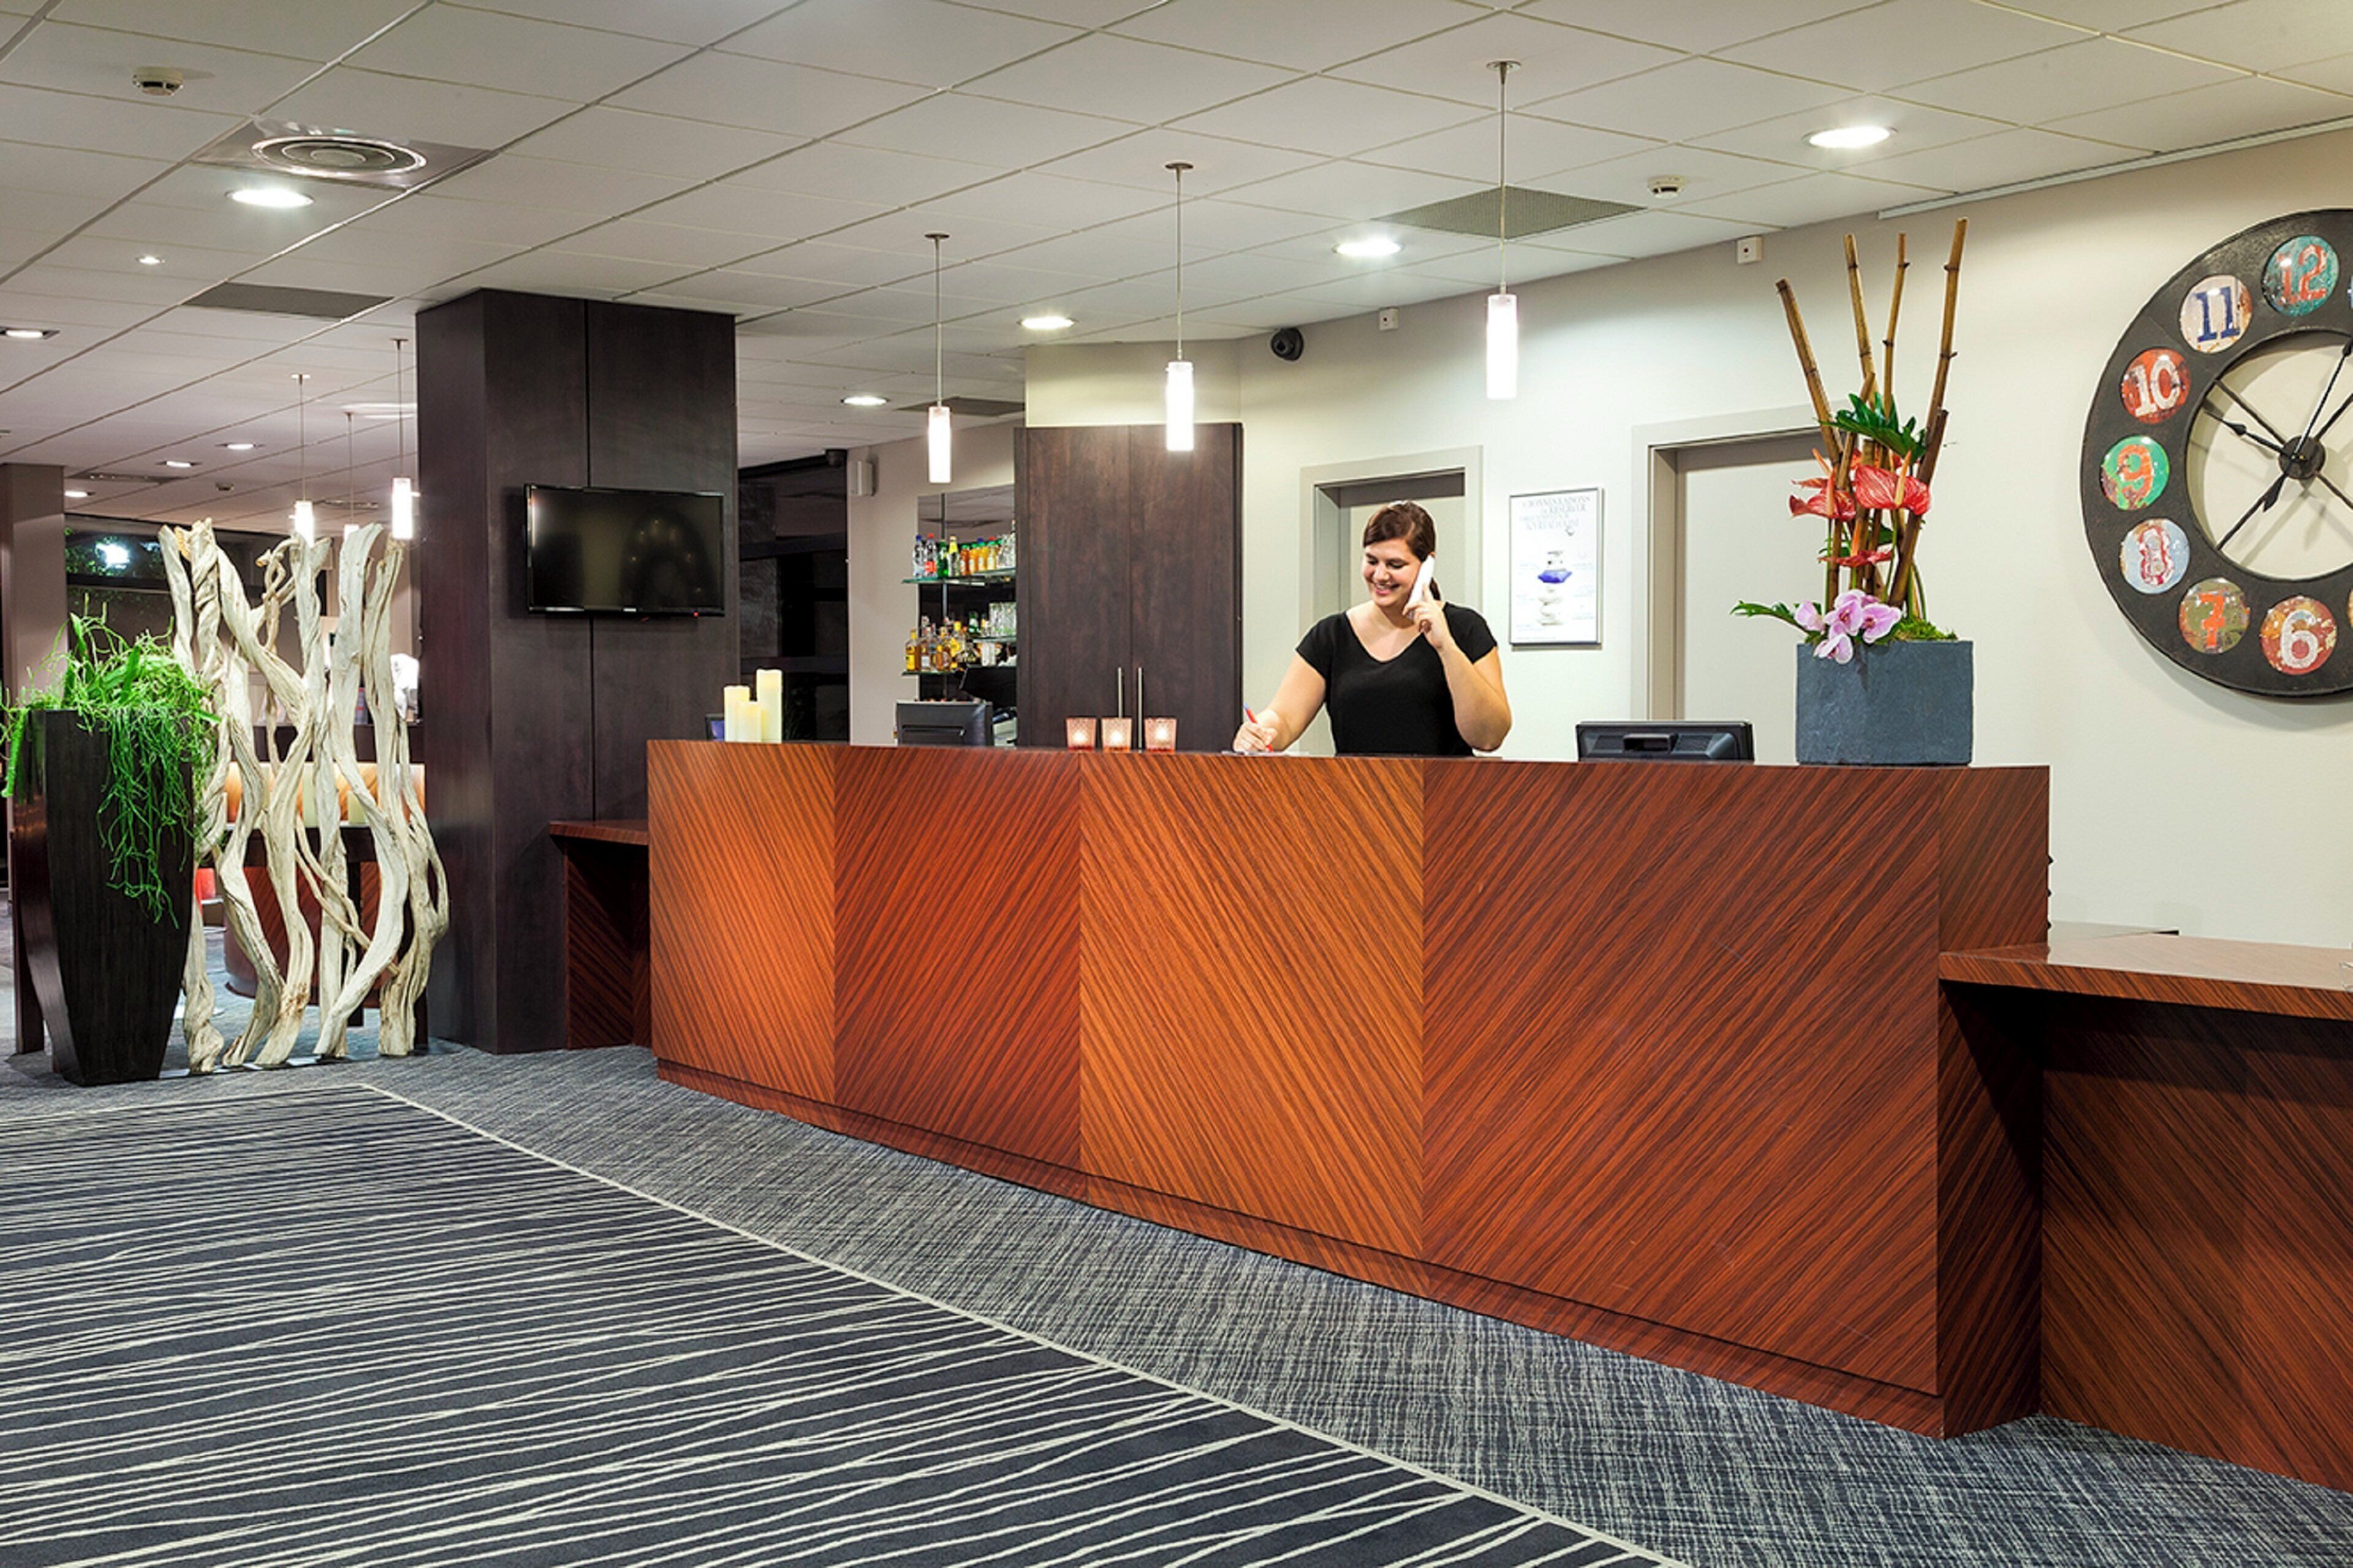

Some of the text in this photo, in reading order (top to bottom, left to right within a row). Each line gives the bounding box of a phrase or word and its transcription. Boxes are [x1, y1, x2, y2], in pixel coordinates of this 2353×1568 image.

[2276, 244, 2328, 306] 12
[2192, 286, 2240, 343] 11
[2132, 355, 2180, 417] 10
[2116, 444, 2153, 507] 9
[2138, 526, 2174, 586] 8
[2199, 589, 2226, 649] 7
[2280, 610, 2319, 669] 6
